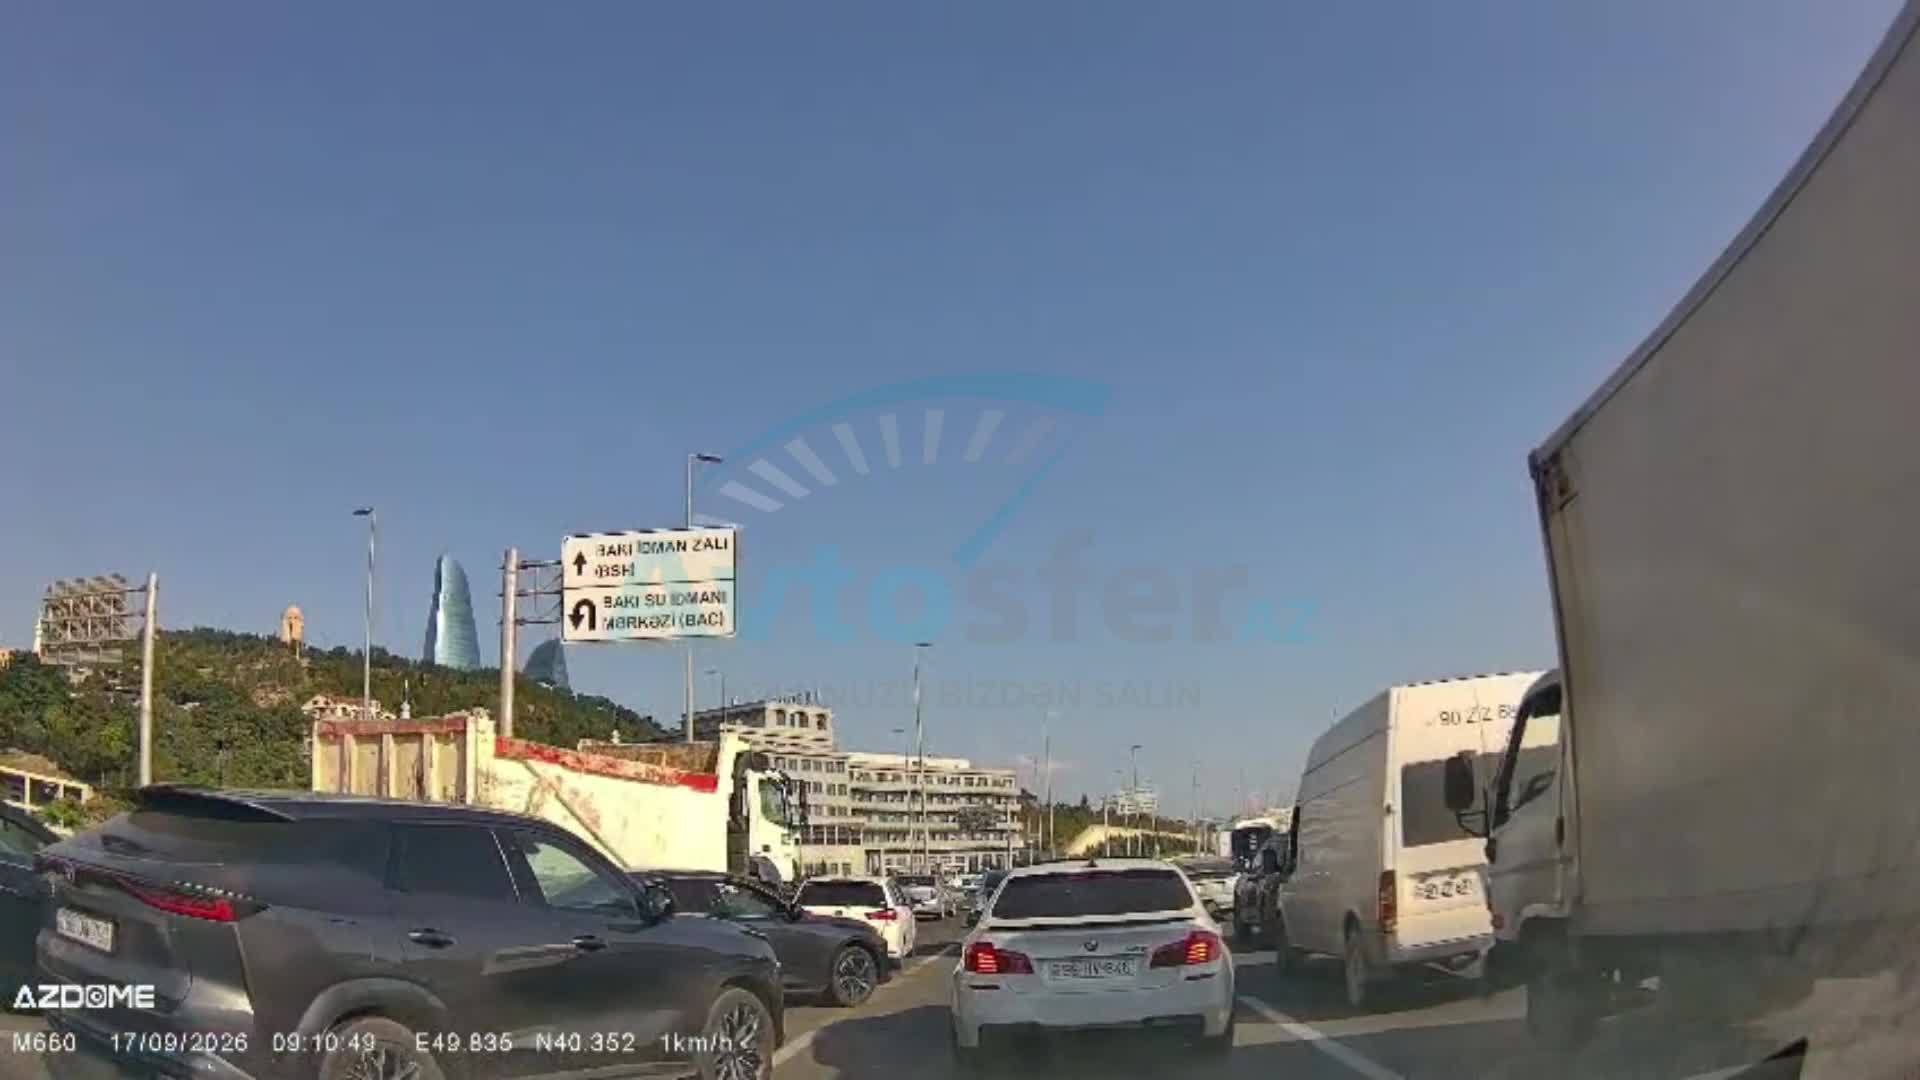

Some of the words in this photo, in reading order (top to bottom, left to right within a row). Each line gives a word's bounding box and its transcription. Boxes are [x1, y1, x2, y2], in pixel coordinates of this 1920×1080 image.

[595, 543, 633, 557] BAKI
[692, 536, 728, 552] ZALI
[603, 595, 640, 609] BAKI
[644, 593, 667, 607] SU
[1440, 711, 1461, 726] 90
